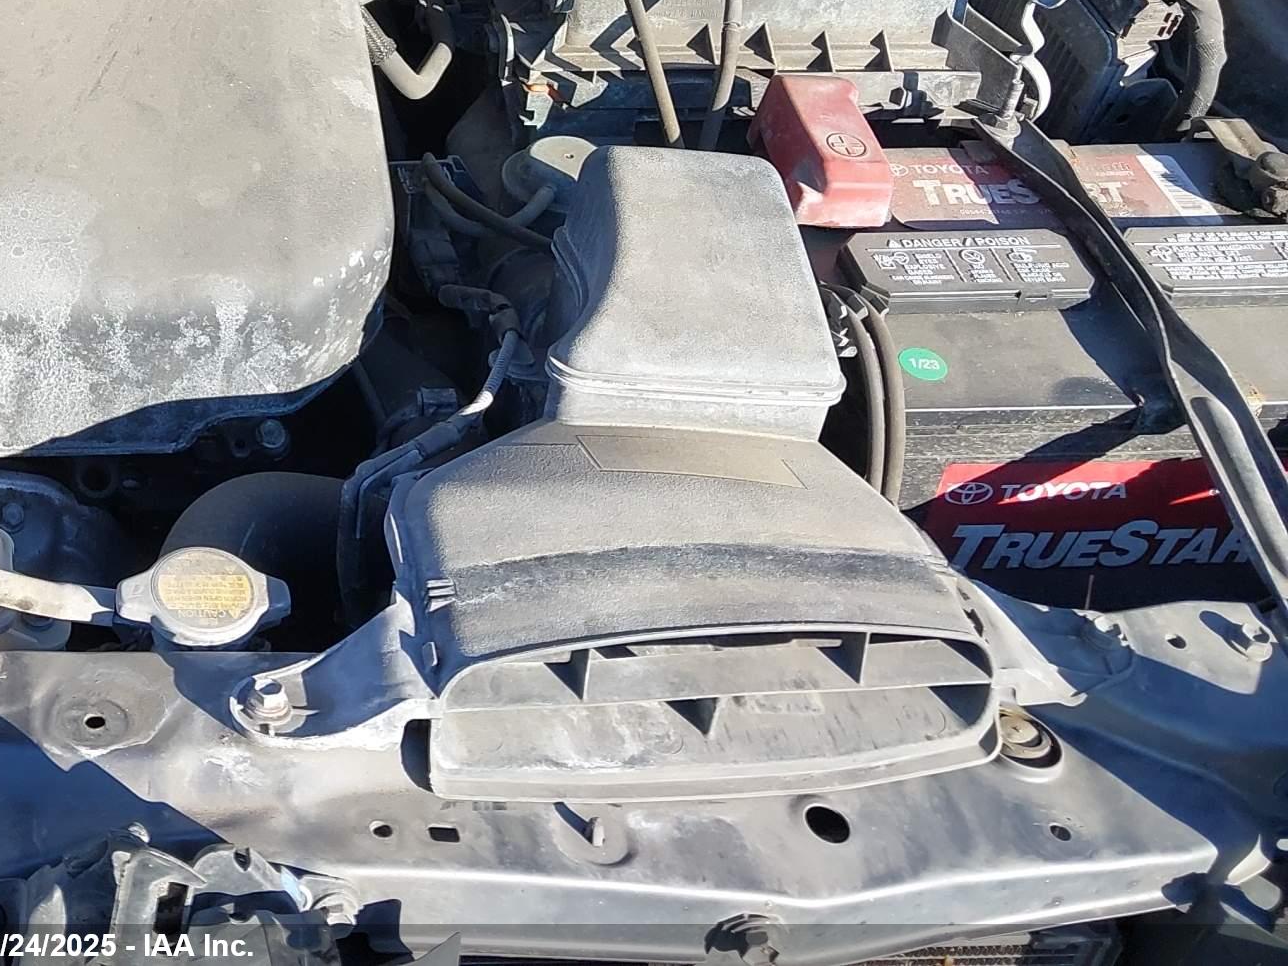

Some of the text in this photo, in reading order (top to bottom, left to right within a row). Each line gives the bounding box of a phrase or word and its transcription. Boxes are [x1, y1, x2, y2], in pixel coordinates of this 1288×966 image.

[913, 164, 988, 175] TOYOTA
[902, 238, 962, 247] DANGER
[975, 237, 1030, 246] POISON
[908, 358, 940, 370] 1/23
[1001, 482, 1127, 502] TOYOTA
[178, 609, 226, 618] CAUTION
